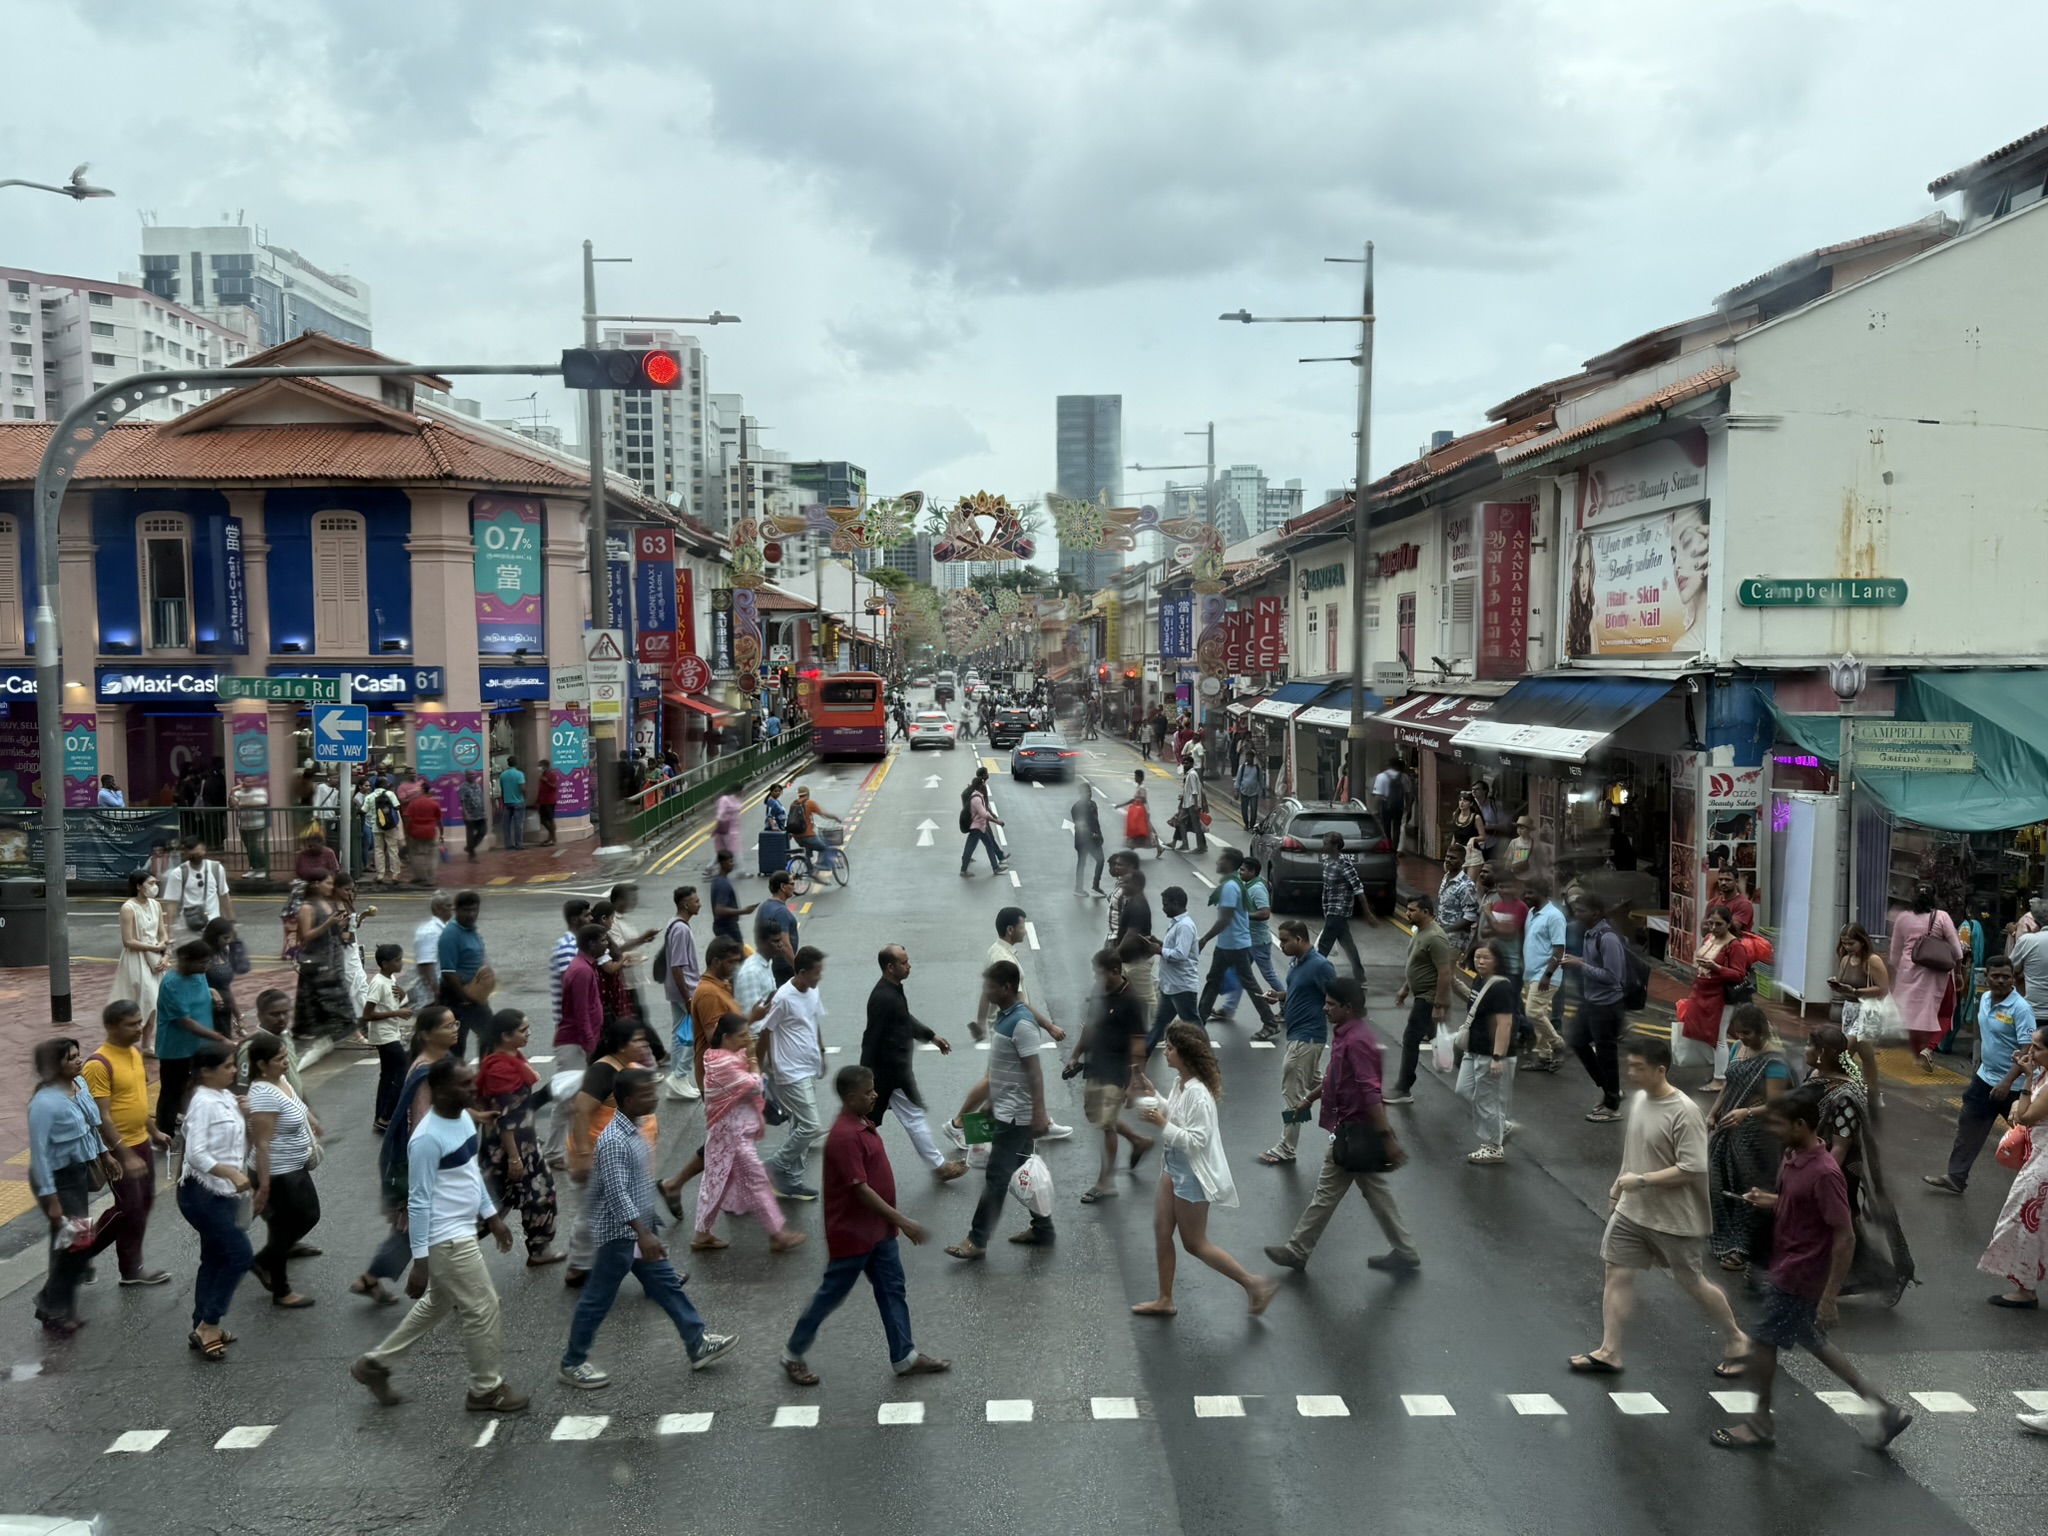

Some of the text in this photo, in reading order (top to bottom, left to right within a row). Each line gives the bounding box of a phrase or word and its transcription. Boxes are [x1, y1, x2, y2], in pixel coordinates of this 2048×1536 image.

[1639, 479, 1669, 501] Beauty
[484, 526, 532, 551] 0.7%
[642, 536, 667, 554] 63
[227, 556, 239, 628] Maxi-Cash
[648, 569, 656, 619] MONEYMAX
[1509, 530, 1525, 658] ANANDA BHAVAN
[1637, 585, 1660, 605] Skin
[1751, 582, 1896, 602] Campbell Lane
[675, 571, 687, 651] Manikya
[1640, 607, 1660, 627] Nail
[1227, 615, 1240, 671] NICE
[1260, 601, 1275, 667] NICE
[122, 674, 218, 693] Maxi-Cas
[415, 671, 440, 689] 61
[676, 659, 703, 689] 當
[228, 679, 335, 698] Buffalo Rd
[552, 731, 580, 746] 0.7%
[1862, 727, 1965, 740] CAMPBELL LANE
[66, 736, 95, 752] 0.7%
[317, 744, 362, 756] ONE WAY
[1708, 799, 1756, 809] Beauty Salon
